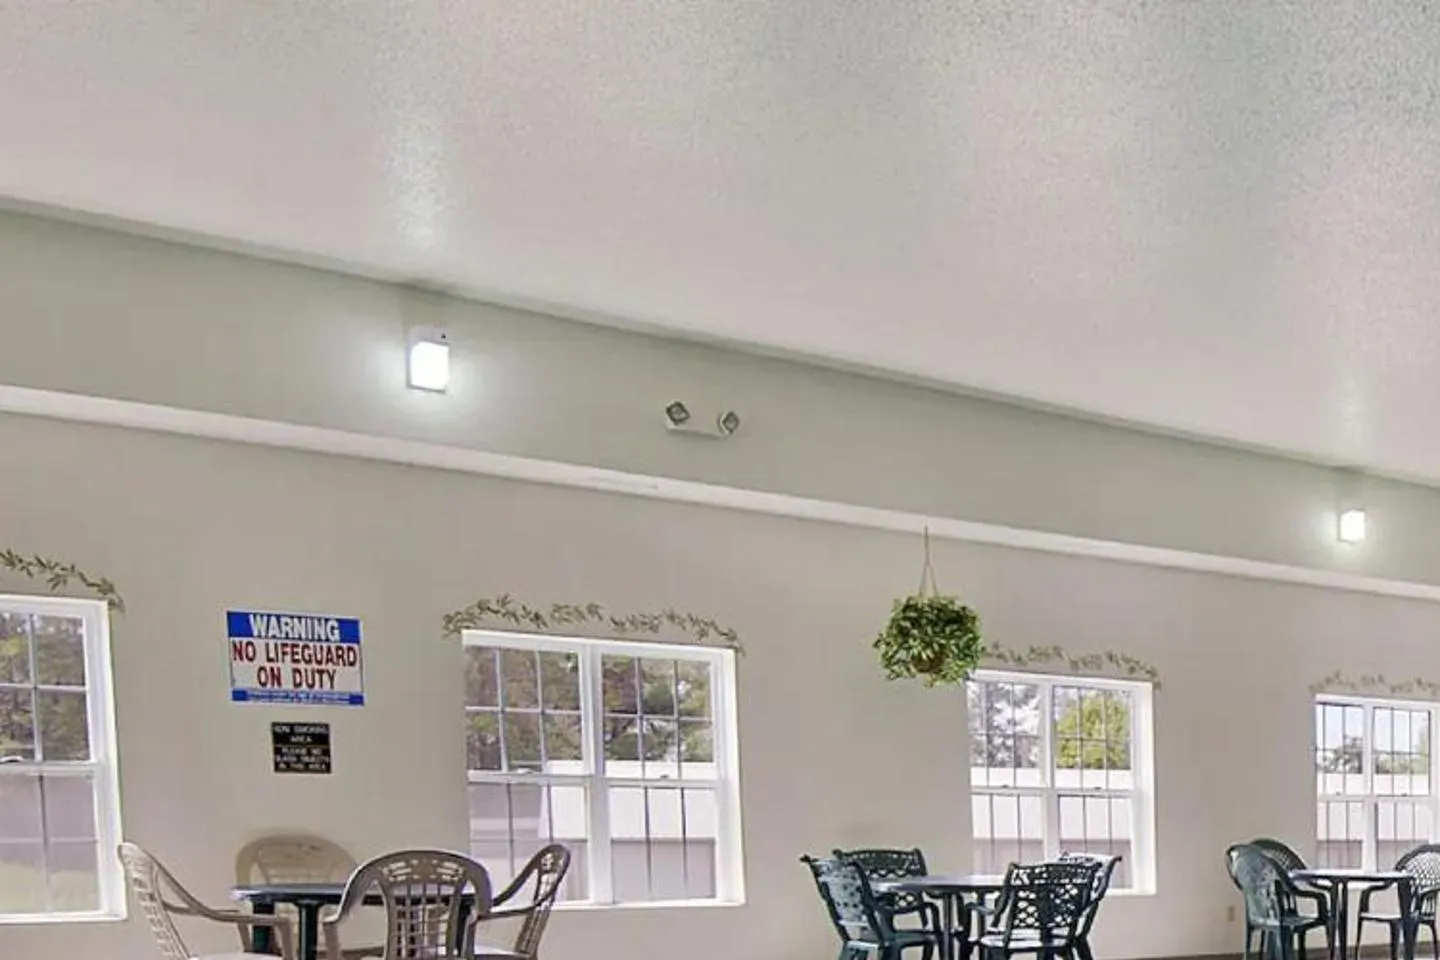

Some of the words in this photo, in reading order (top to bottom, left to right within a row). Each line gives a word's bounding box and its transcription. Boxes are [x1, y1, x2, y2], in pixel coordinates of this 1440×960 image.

[248, 613, 341, 641] WARNING
[231, 640, 256, 662] NO
[265, 642, 358, 667] LIFEGUARD
[256, 666, 282, 688] ON
[291, 667, 337, 690] DUTY
